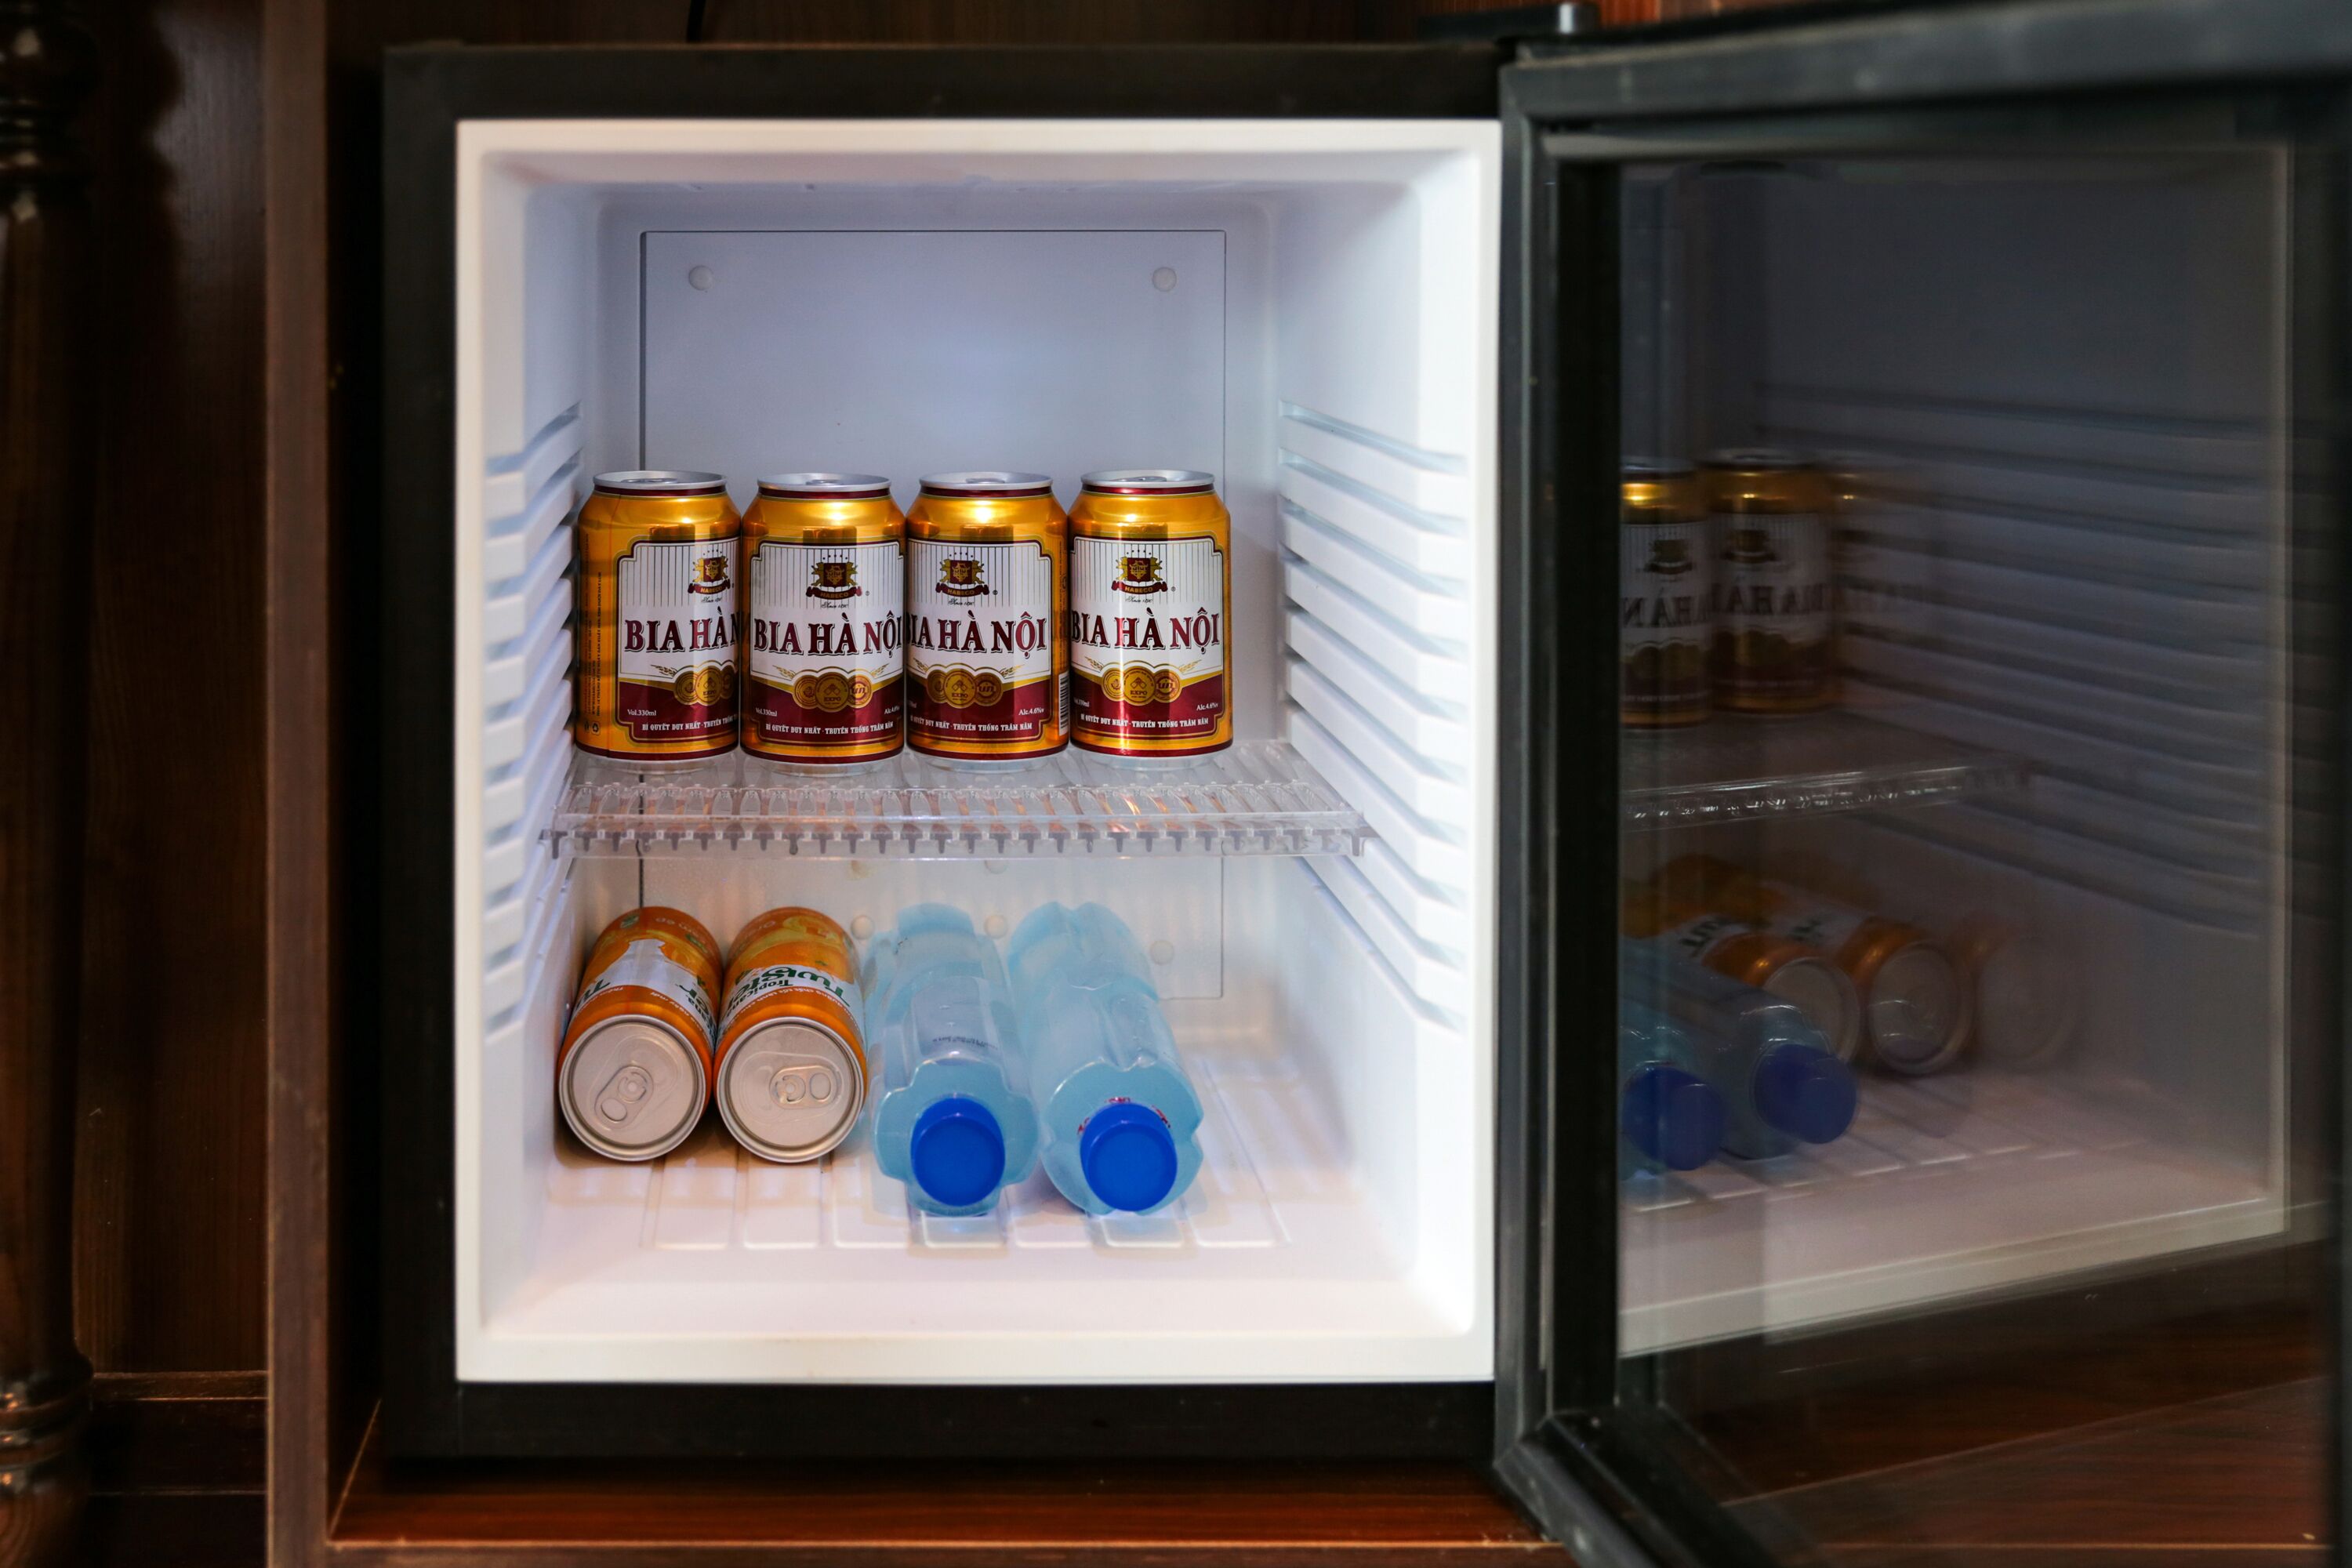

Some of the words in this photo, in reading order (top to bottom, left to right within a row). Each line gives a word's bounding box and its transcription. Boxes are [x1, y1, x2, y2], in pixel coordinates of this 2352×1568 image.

[624, 619, 685, 653] BIA
[689, 606, 728, 652] HÀ
[754, 618, 804, 655] BIA
[808, 612, 859, 656] HÀ
[863, 610, 902, 658] NỘI
[938, 610, 987, 653] HÀ
[991, 611, 1047, 659] NỘI
[1072, 611, 1110, 648] BIA
[1114, 607, 1166, 650] HÀ
[1170, 607, 1220, 654] NỘI
[1101, 717, 1111, 725] DUY
